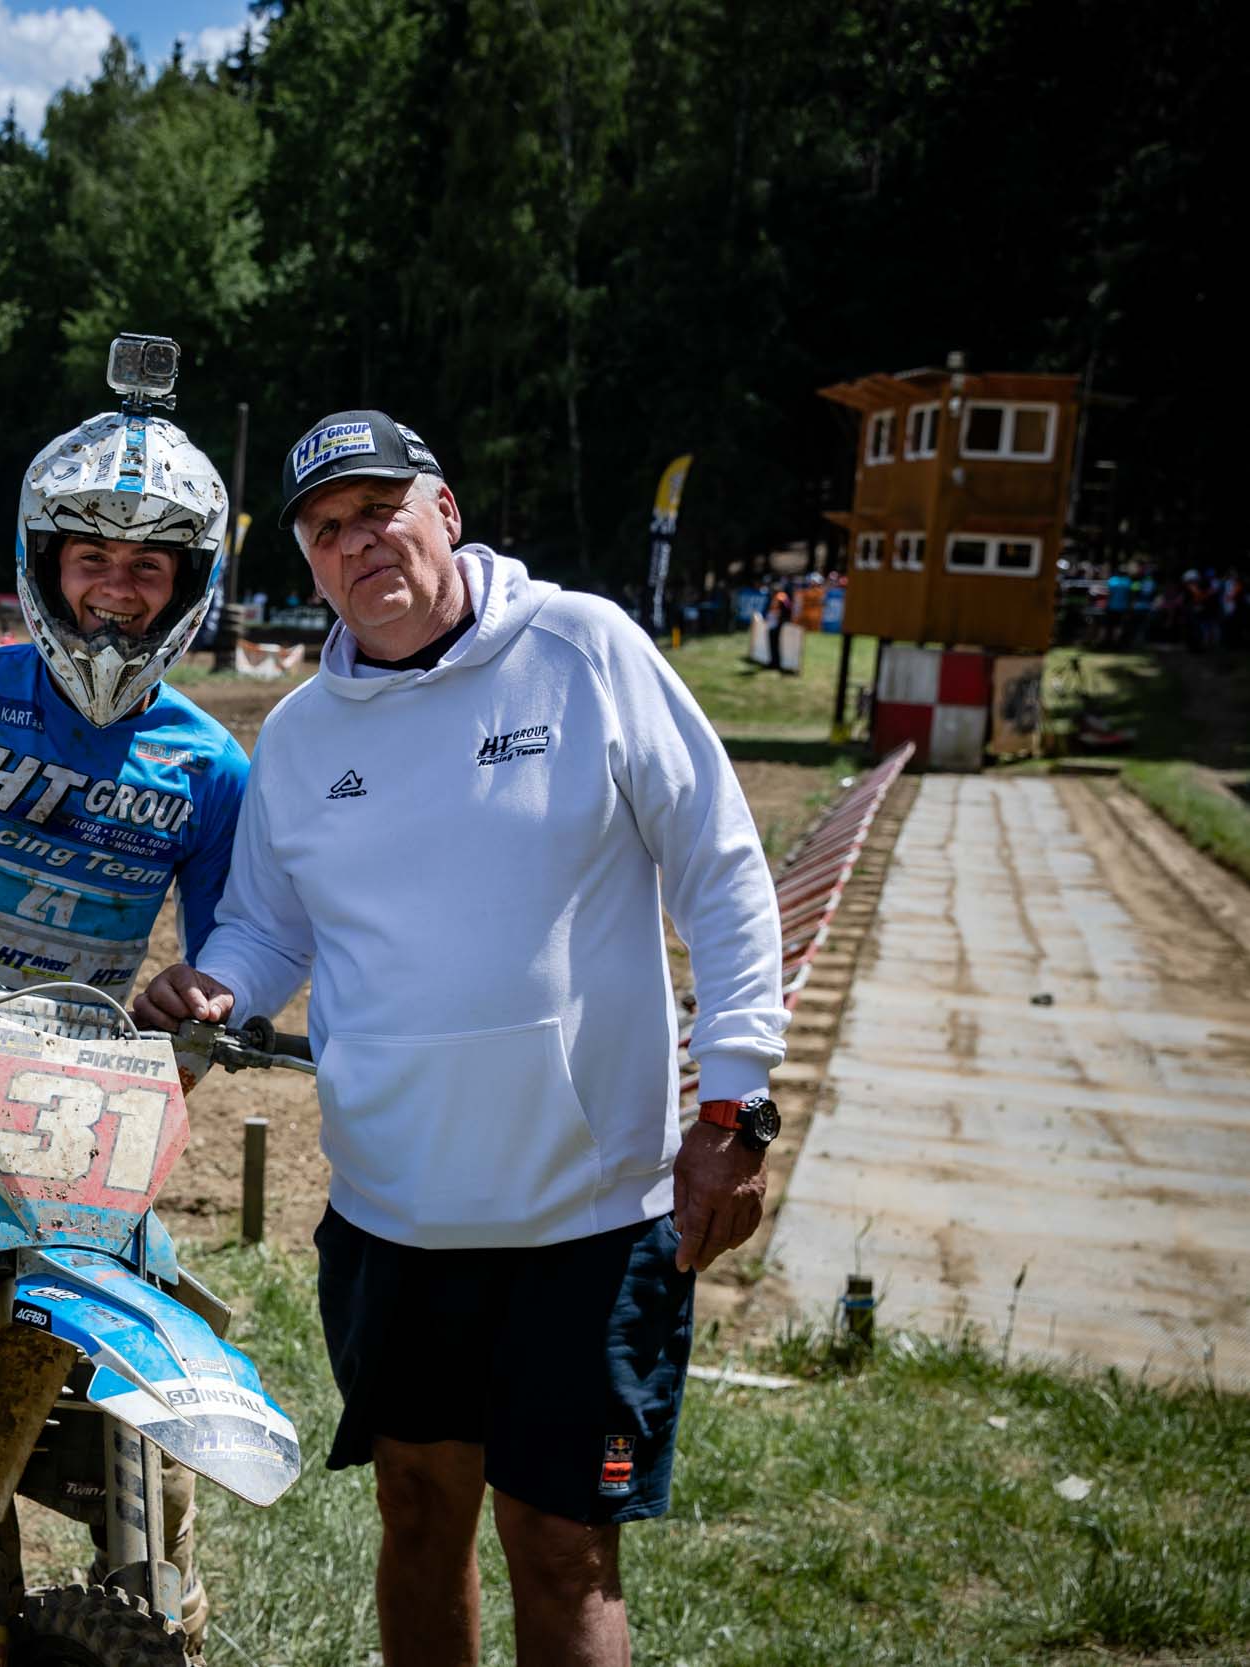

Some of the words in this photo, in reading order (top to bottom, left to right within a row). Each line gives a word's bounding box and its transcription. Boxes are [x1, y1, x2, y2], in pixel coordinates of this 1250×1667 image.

[296, 430, 327, 467] HT
[327, 423, 370, 439] GROUP
[298, 450, 331, 476] Racing
[334, 441, 370, 455] Team
[479, 733, 512, 757] HT
[513, 725, 548, 740] GROUP
[478, 752, 513, 767] Racing
[516, 748, 546, 757] Team
[84, 779, 195, 834] GROUP
[68, 818, 102, 835] FLOOR
[110, 829, 139, 843] STEEL
[147, 838, 172, 850] ROAD
[81, 833, 105, 846] REAL
[85, 851, 169, 886] Team
[29, 953, 72, 973] INVEST
[88, 968, 121, 986] HT
[76, 1050, 166, 1077] PIKART
[66, 1481, 99, 1497] Twin
